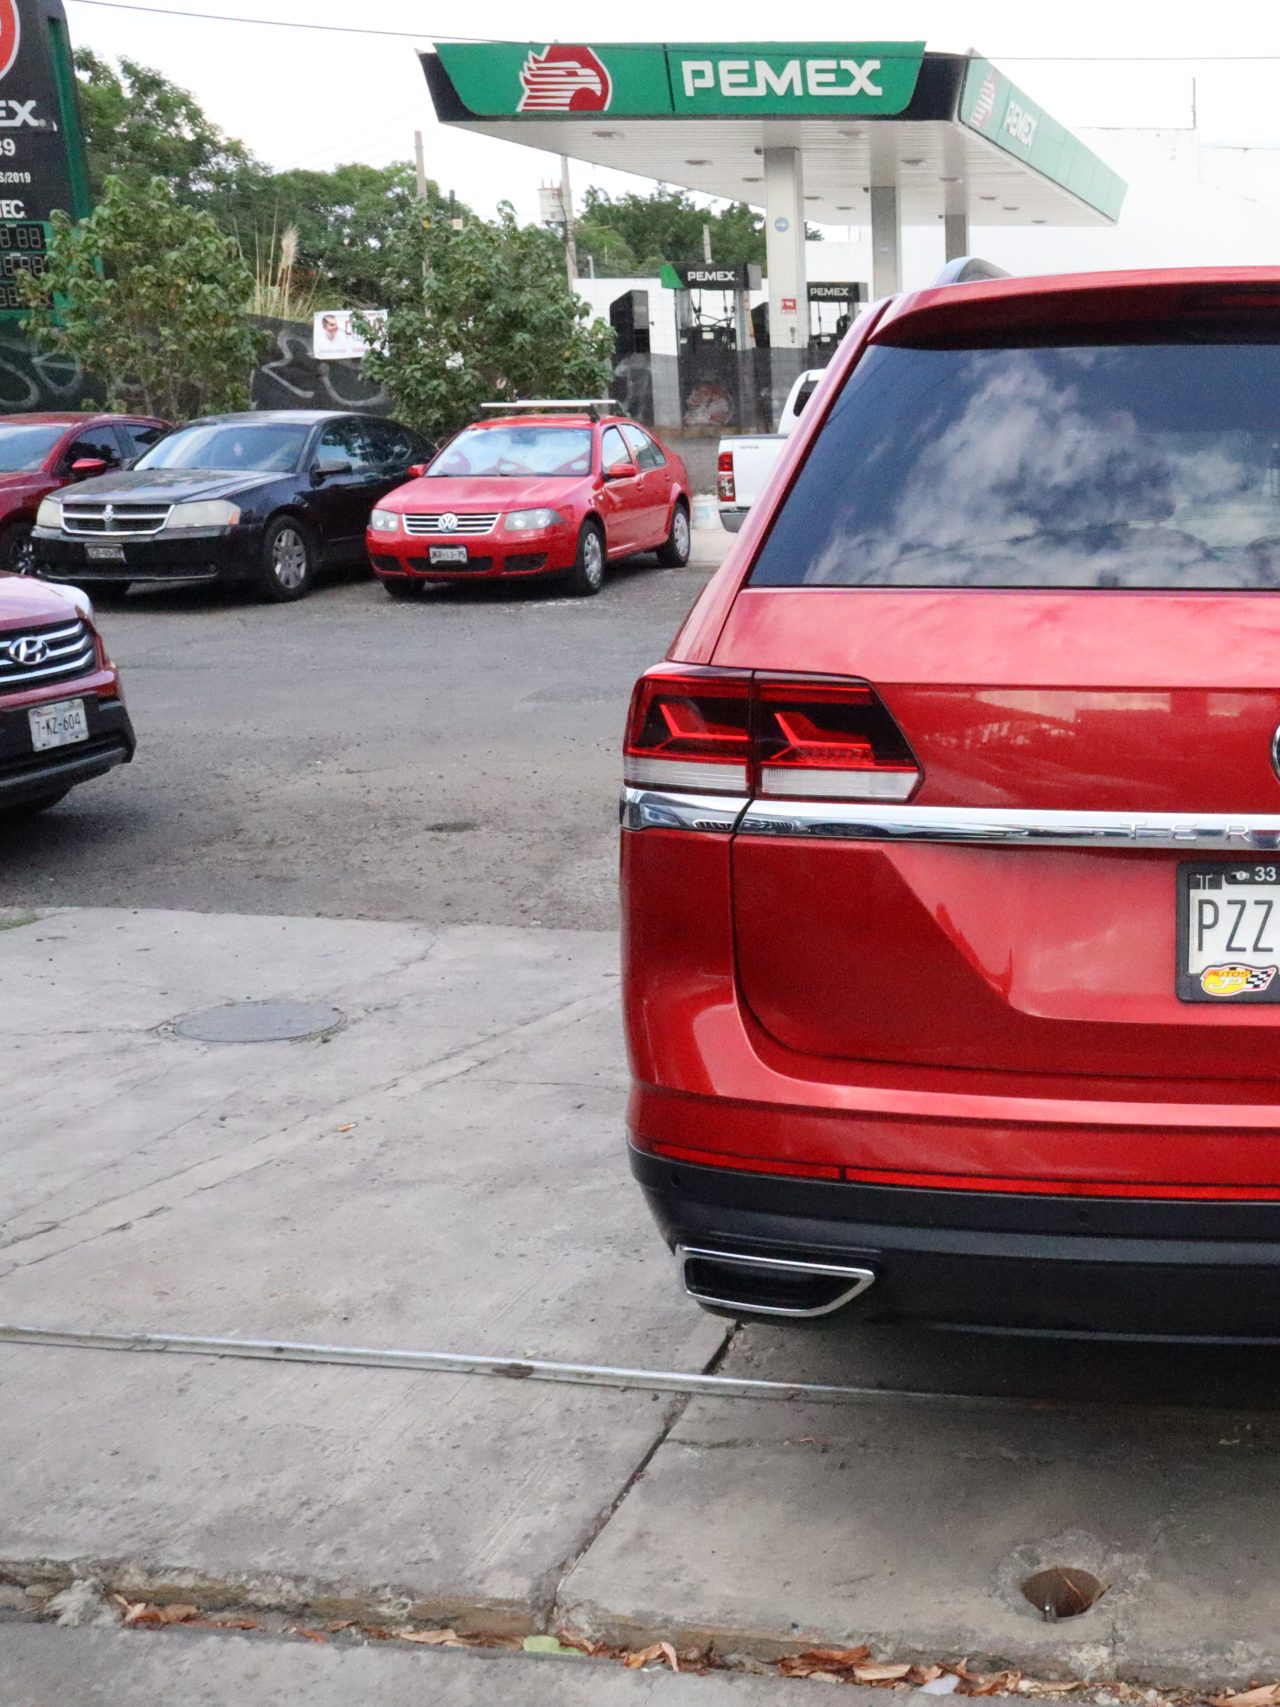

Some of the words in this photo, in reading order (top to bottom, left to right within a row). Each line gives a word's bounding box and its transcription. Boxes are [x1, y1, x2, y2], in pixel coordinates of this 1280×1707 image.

[681, 60, 883, 96] PEMEX
[0, 138, 16, 156] 9
[0, 200, 25, 218] EC
[687, 271, 735, 281] PEMEX
[810, 287, 849, 296] PEMEX
[1254, 867, 1277, 882] 33
[1204, 970, 1249, 978] AUTOS
